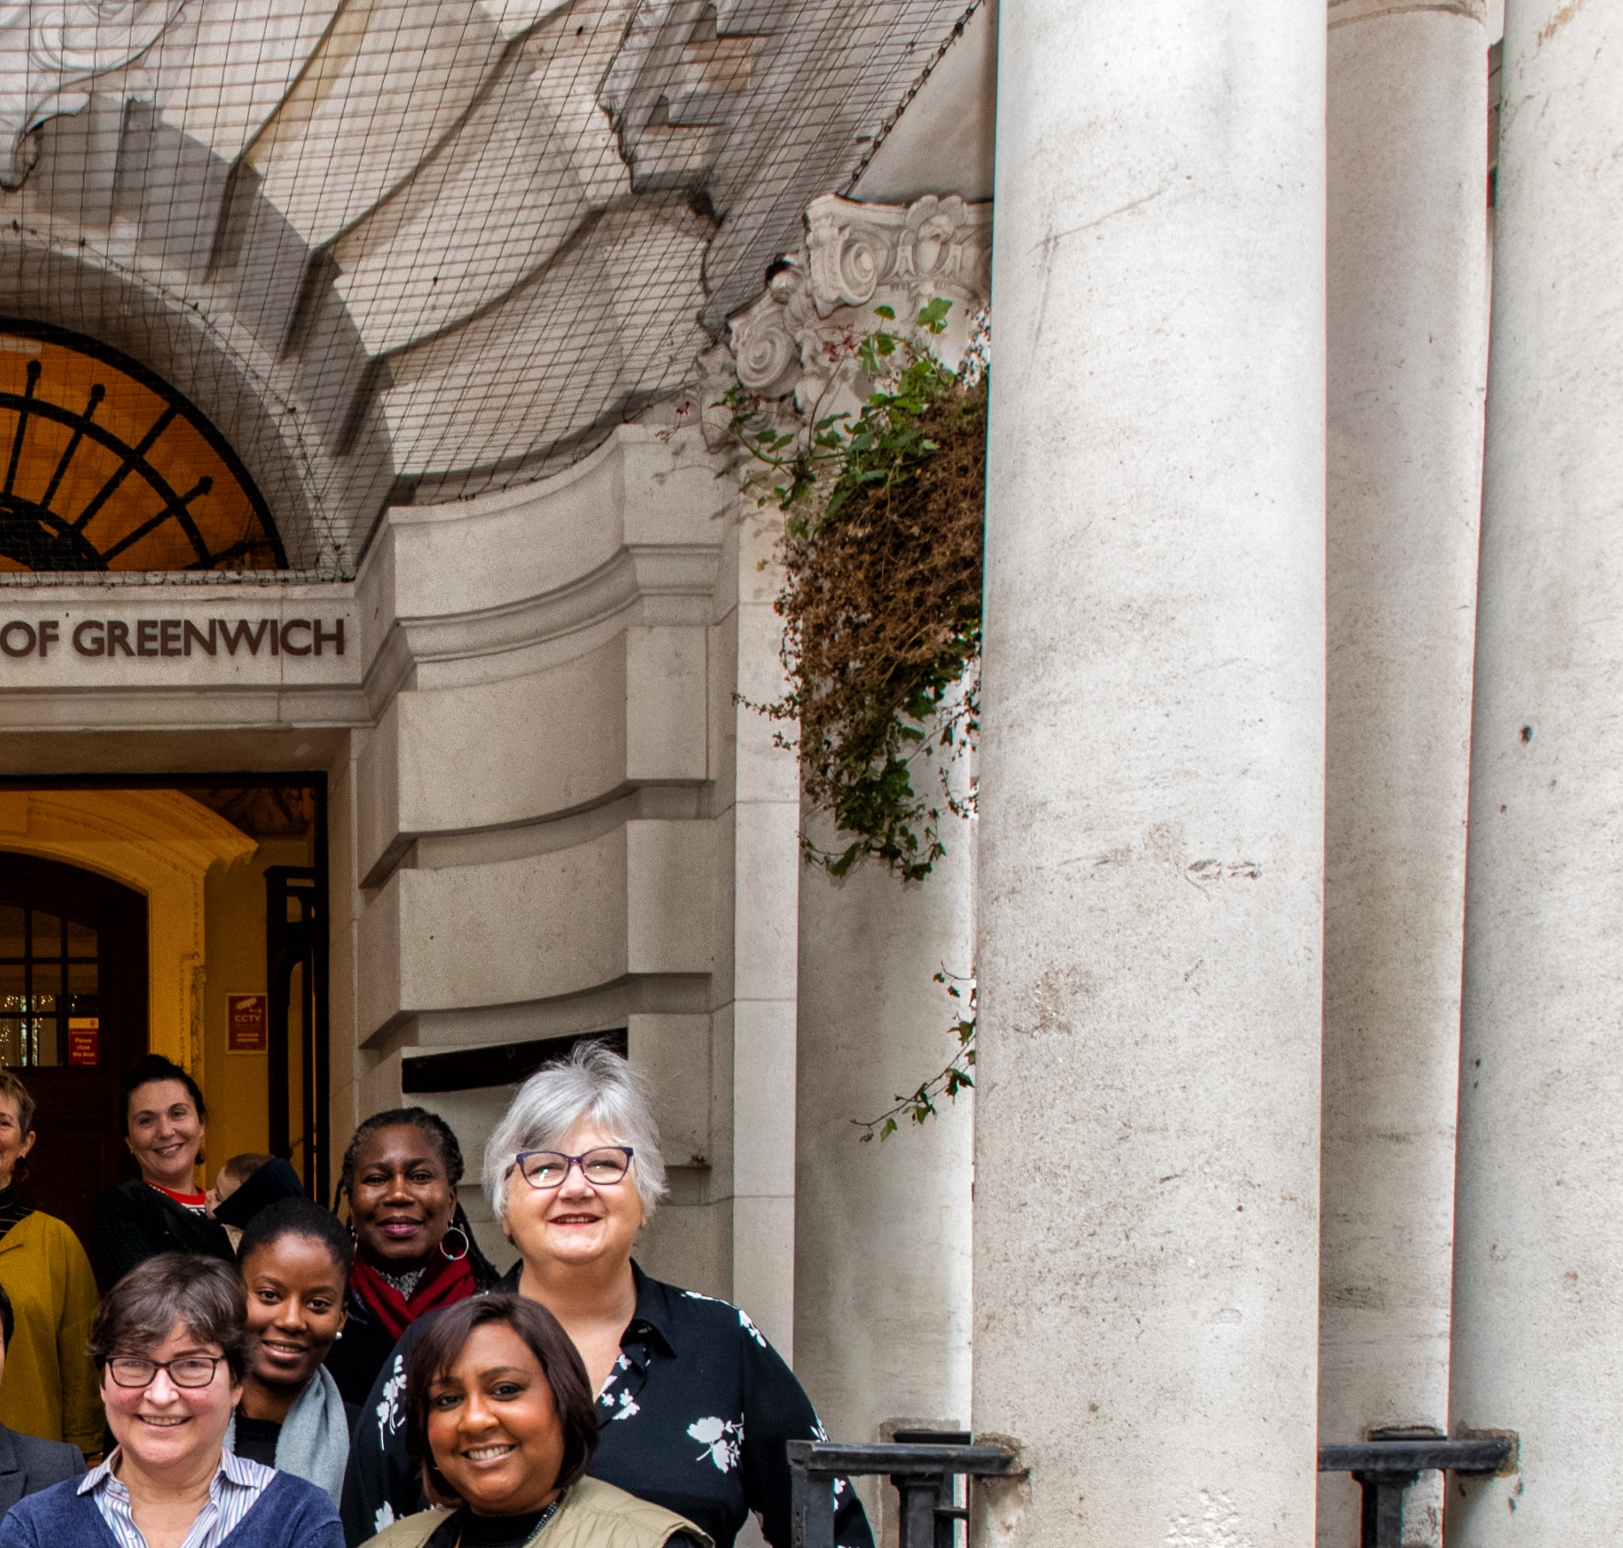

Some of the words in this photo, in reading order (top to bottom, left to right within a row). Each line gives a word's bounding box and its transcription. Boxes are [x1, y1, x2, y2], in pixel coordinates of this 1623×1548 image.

[0, 619, 60, 659] OF
[72, 618, 346, 658] GREENWICH
[235, 1014, 261, 1022] CCTV
